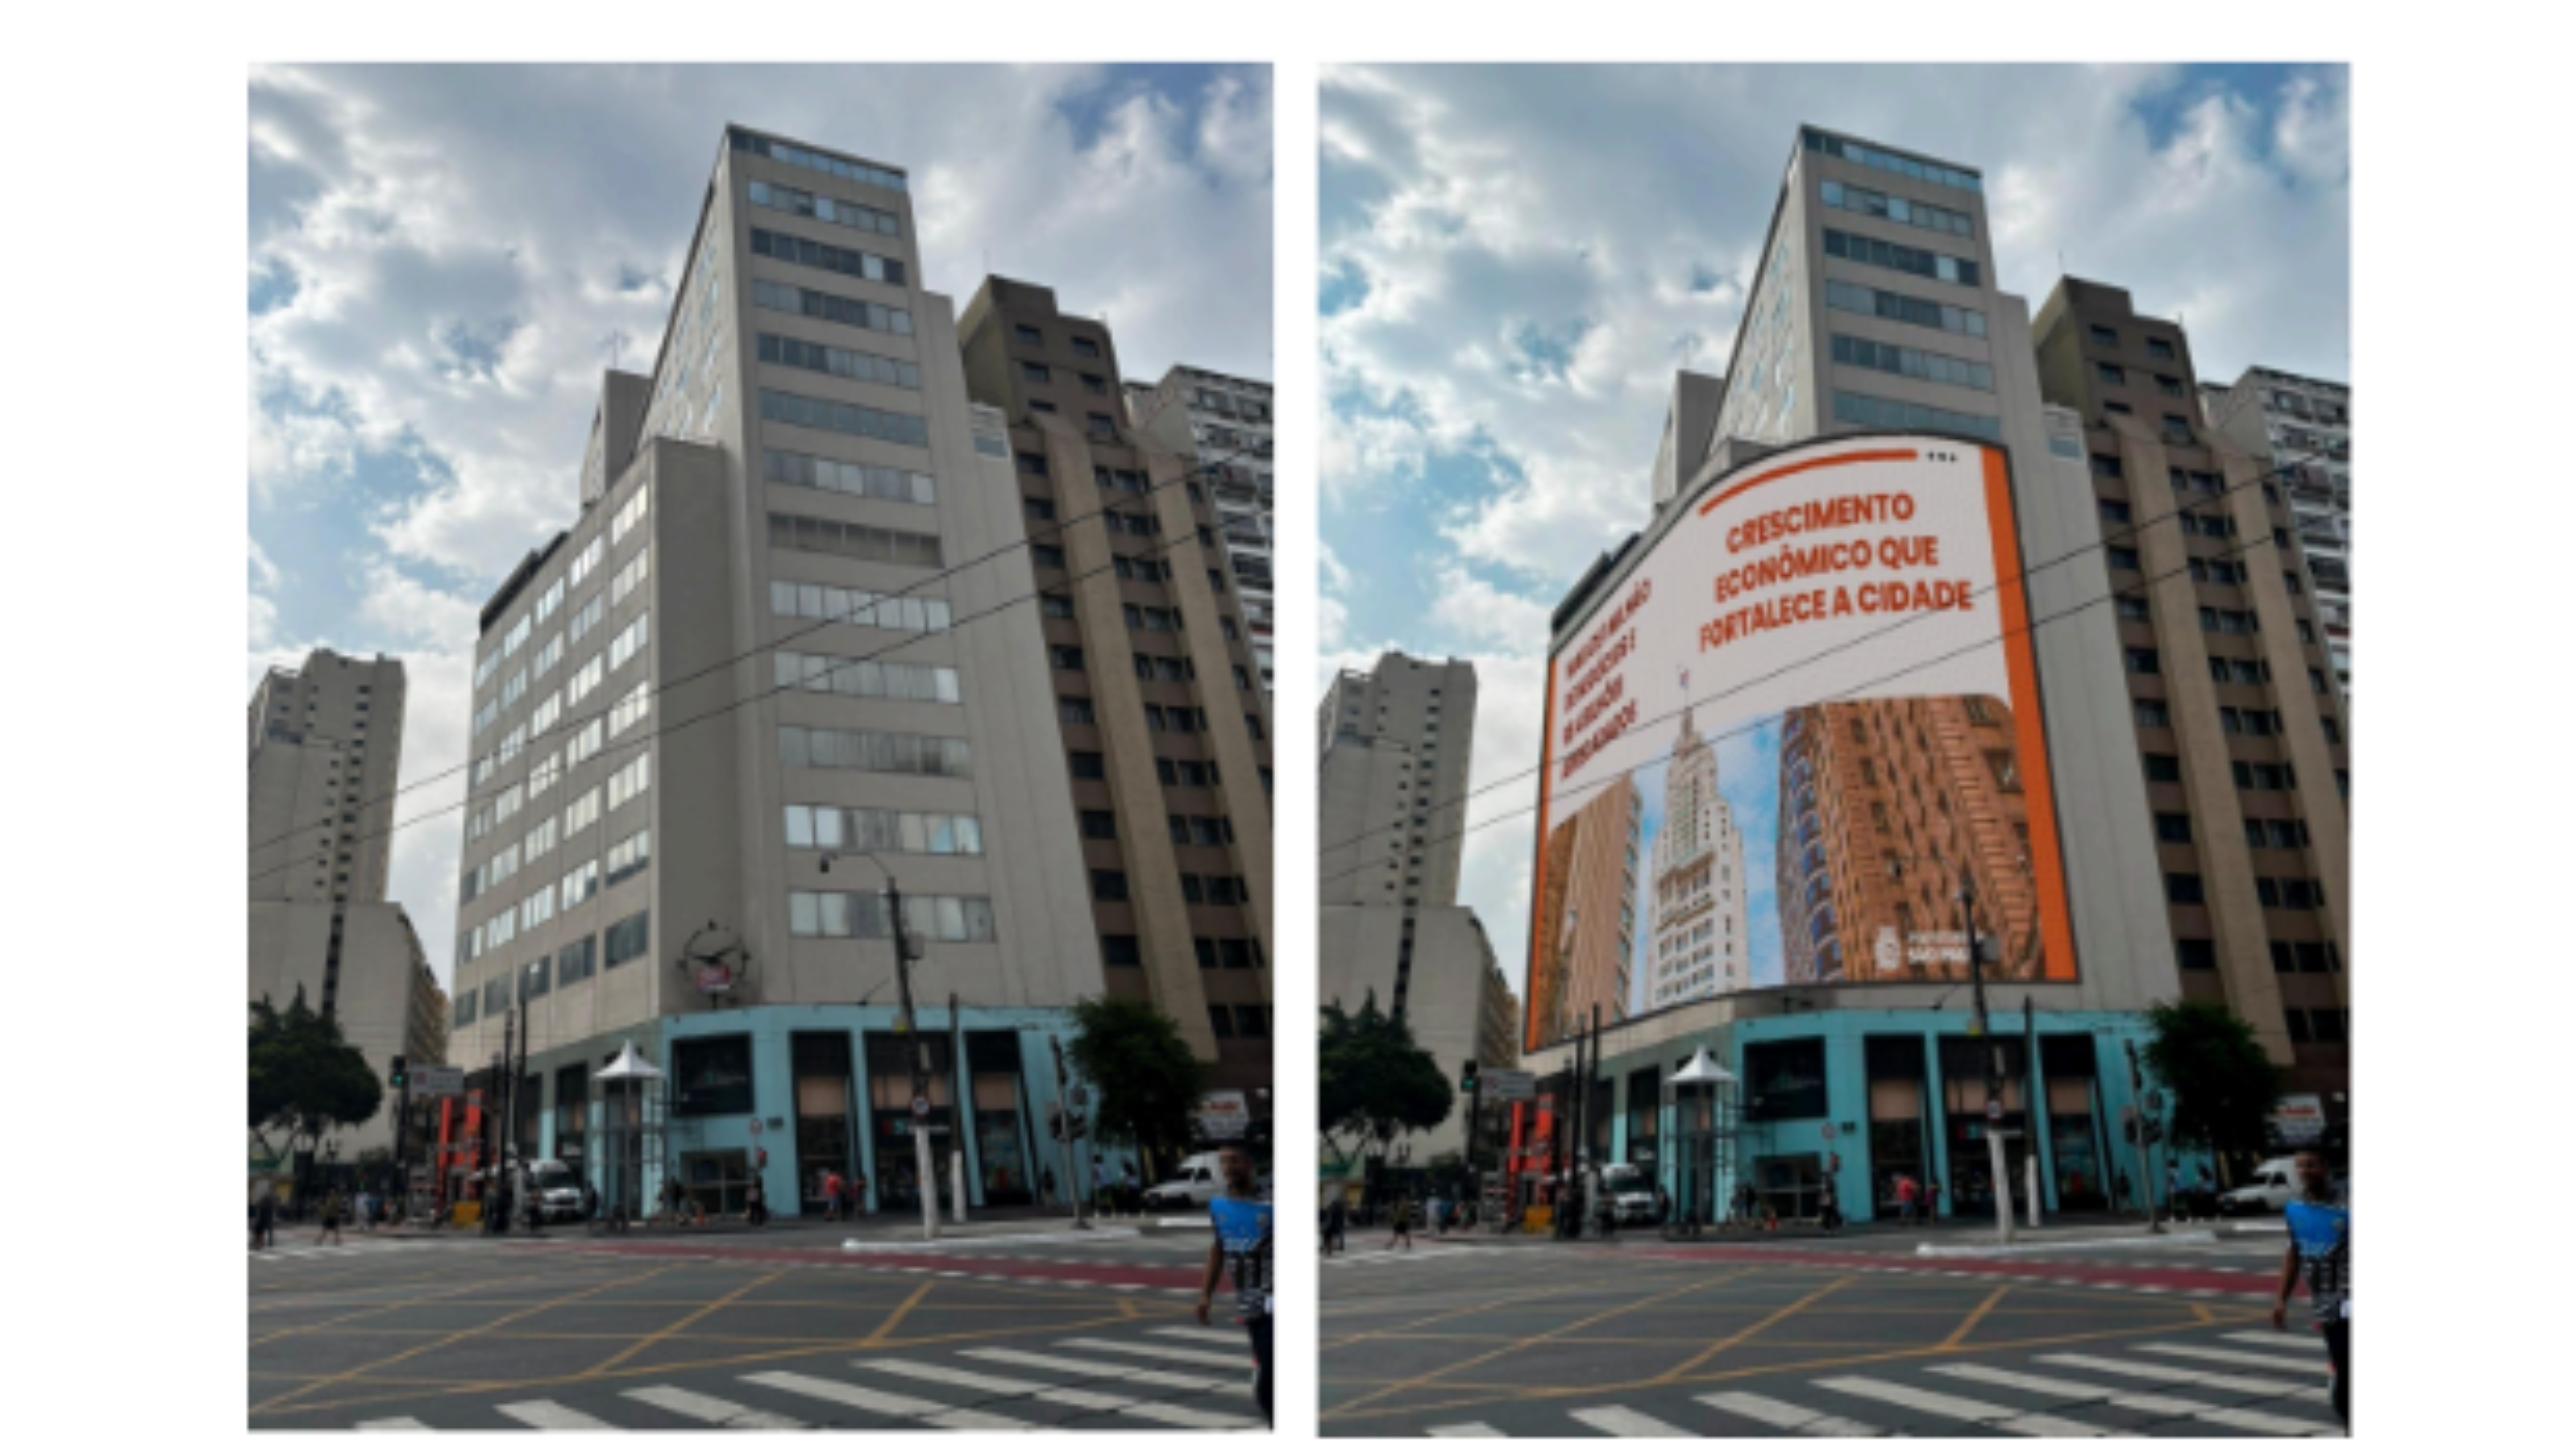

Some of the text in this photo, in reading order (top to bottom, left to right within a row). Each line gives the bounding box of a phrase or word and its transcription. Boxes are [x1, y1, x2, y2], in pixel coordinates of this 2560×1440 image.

[1726, 491, 1915, 554] CRESCIMENTO
[1715, 536, 1938, 603] ECONÔMICO QUE
[1700, 580, 1973, 651] FORTALECE A CIDADE
